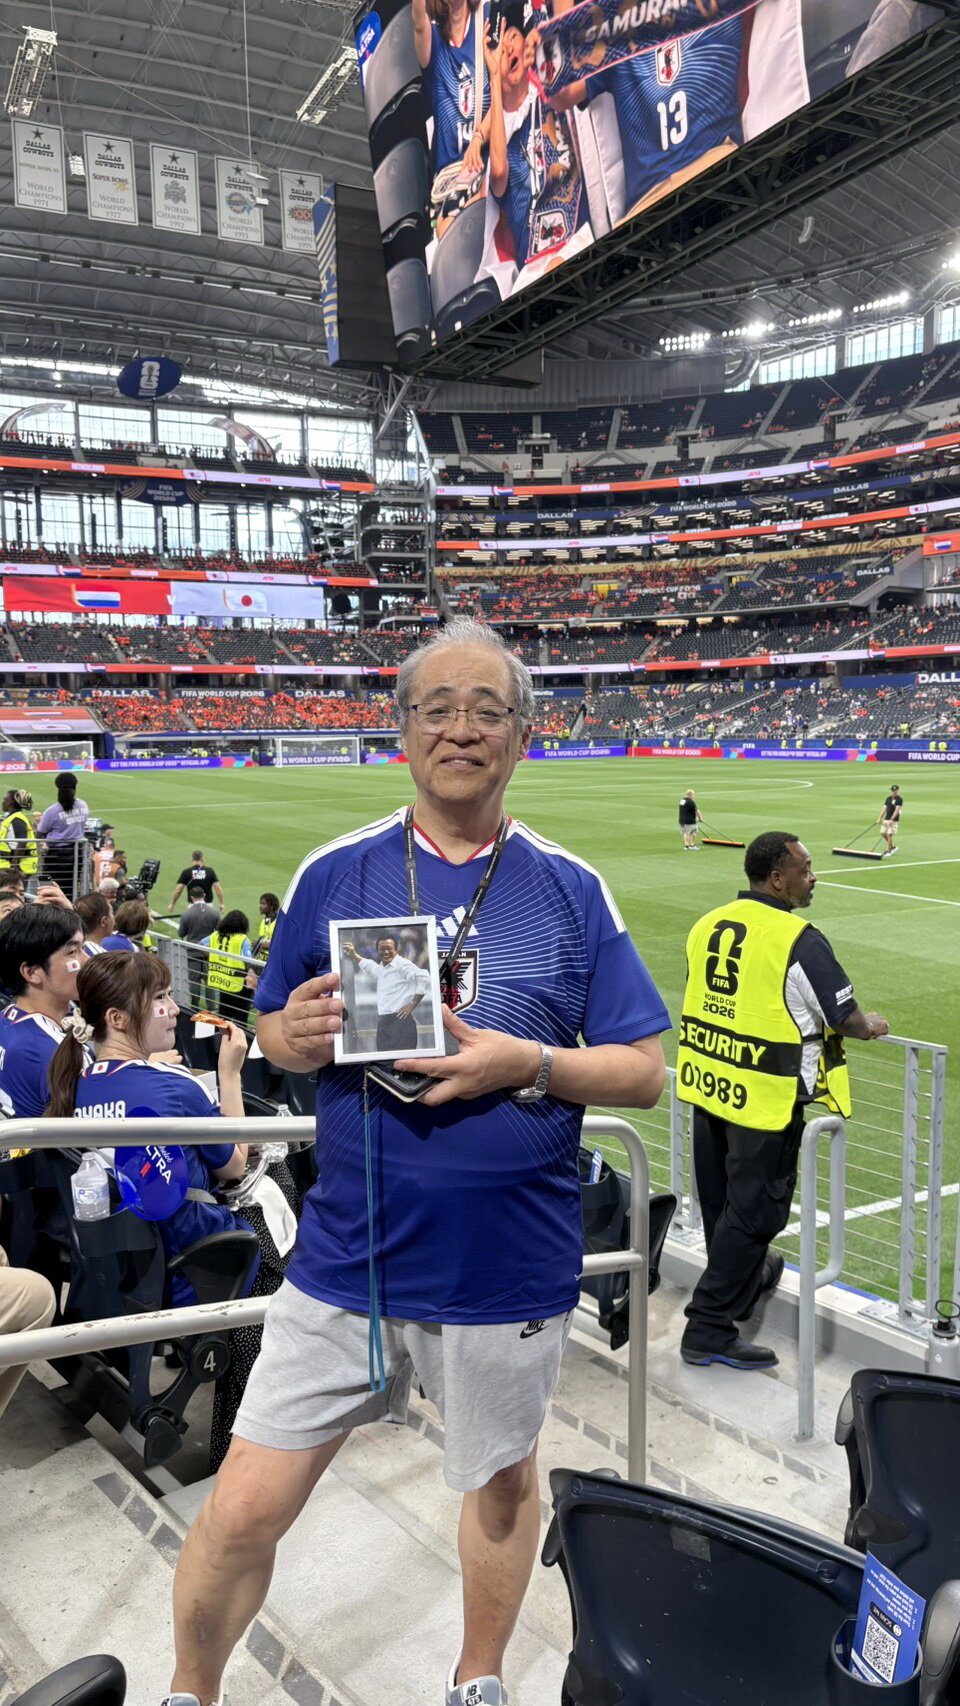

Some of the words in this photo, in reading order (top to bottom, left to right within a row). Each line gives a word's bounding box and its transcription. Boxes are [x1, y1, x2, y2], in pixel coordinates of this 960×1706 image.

[657, 90, 688, 151] 13
[834, 482, 869, 494] DALLAS
[716, 500, 736, 508] 2026
[856, 566, 890, 576] DALLAS
[918, 673, 960, 684] DALL
[92, 690, 150, 698] DALLAS
[199, 690, 224, 698] WORLD
[225, 690, 240, 698] CUP
[240, 690, 264, 698] 2026
[295, 690, 346, 698] DALLAS
[288, 756, 312, 764] WORLD
[908, 752, 922, 760] FIFA
[922, 752, 946, 760] WORLD
[946, 752, 960, 760] CUP
[208, 963, 236, 976] SECURITY
[712, 977, 730, 989] FIFA
[705, 992, 724, 1004] WORLD
[725, 998, 736, 1008] CUP
[703, 1000, 736, 1020] 2026
[680, 1021, 766, 1066] SECURITY
[146, 1145, 172, 1184] LTRA
[526, 1320, 546, 1331] NIKE
[204, 1350, 216, 1372] 4
